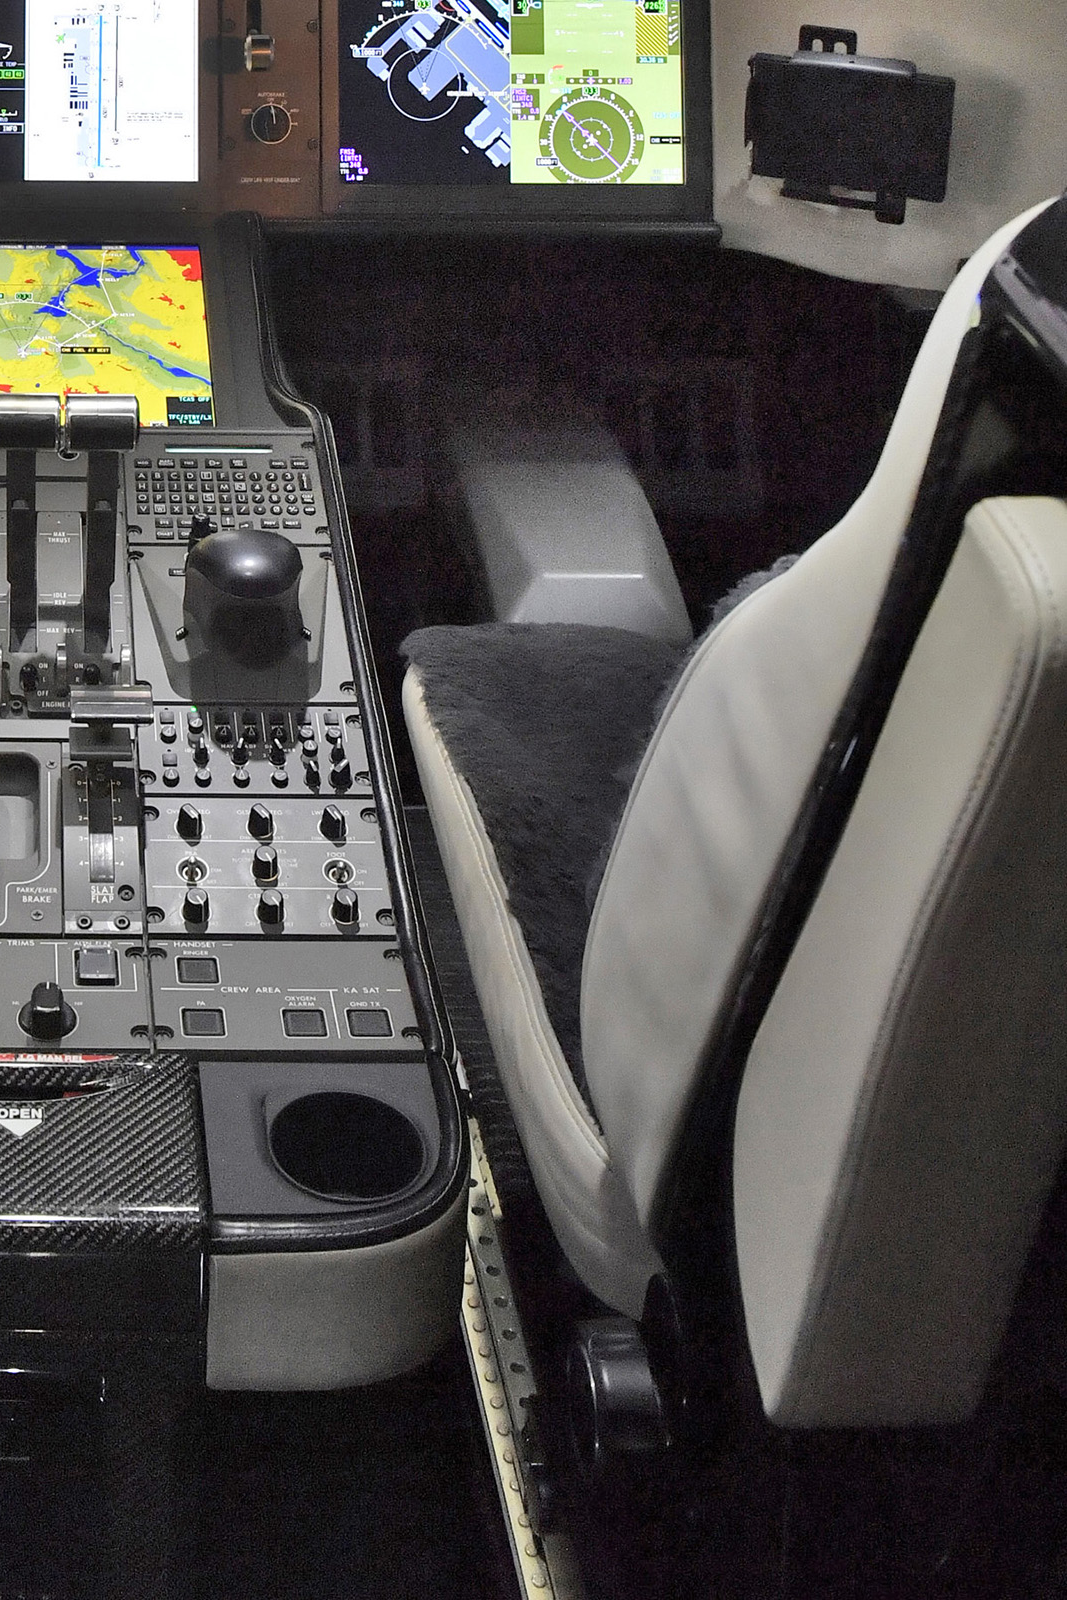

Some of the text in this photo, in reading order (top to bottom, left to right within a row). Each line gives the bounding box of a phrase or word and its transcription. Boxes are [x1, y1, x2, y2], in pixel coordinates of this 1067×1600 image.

[90, 885, 115, 895] SLAT
[22, 895, 51, 904] BRAKE
[90, 894, 114, 904] FLAP
[7, 939, 35, 947] TRIMS
